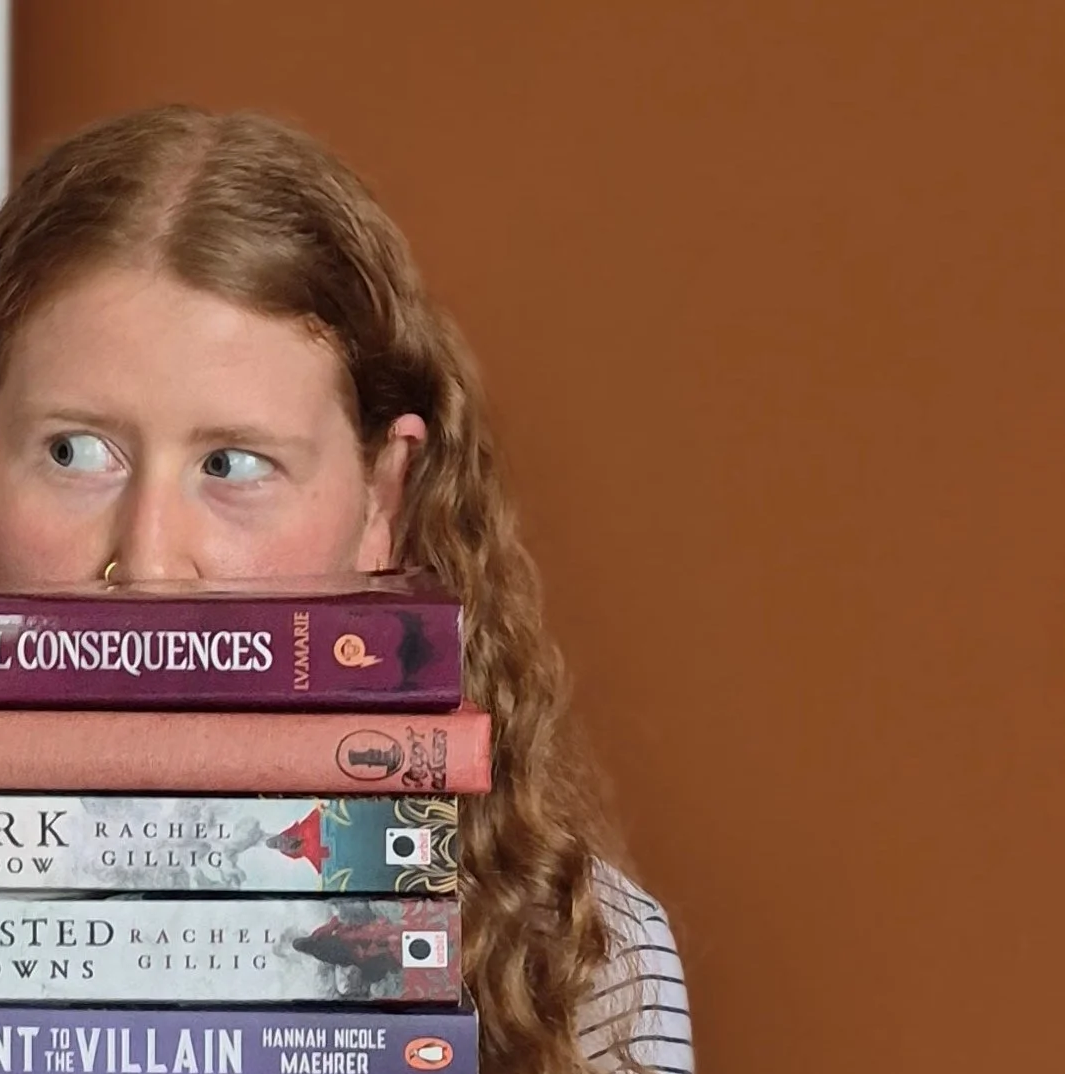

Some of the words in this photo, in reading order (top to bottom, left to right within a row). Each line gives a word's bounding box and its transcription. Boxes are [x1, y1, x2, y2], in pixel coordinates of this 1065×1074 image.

[18, 630, 273, 676] CONSEQUENCES
[94, 822, 232, 841] RACHEL
[100, 849, 225, 869] GILLIG
[130, 928, 277, 945] RACHEL
[137, 953, 267, 971] GILLIG
[50, 1029, 71, 1050] TO
[262, 1028, 327, 1049] HANNAH
[334, 1028, 387, 1050] NICOLE
[76, 1027, 243, 1074] VILLAIN
[45, 1051, 75, 1073] THE
[280, 1053, 370, 1074] MAEHRER
